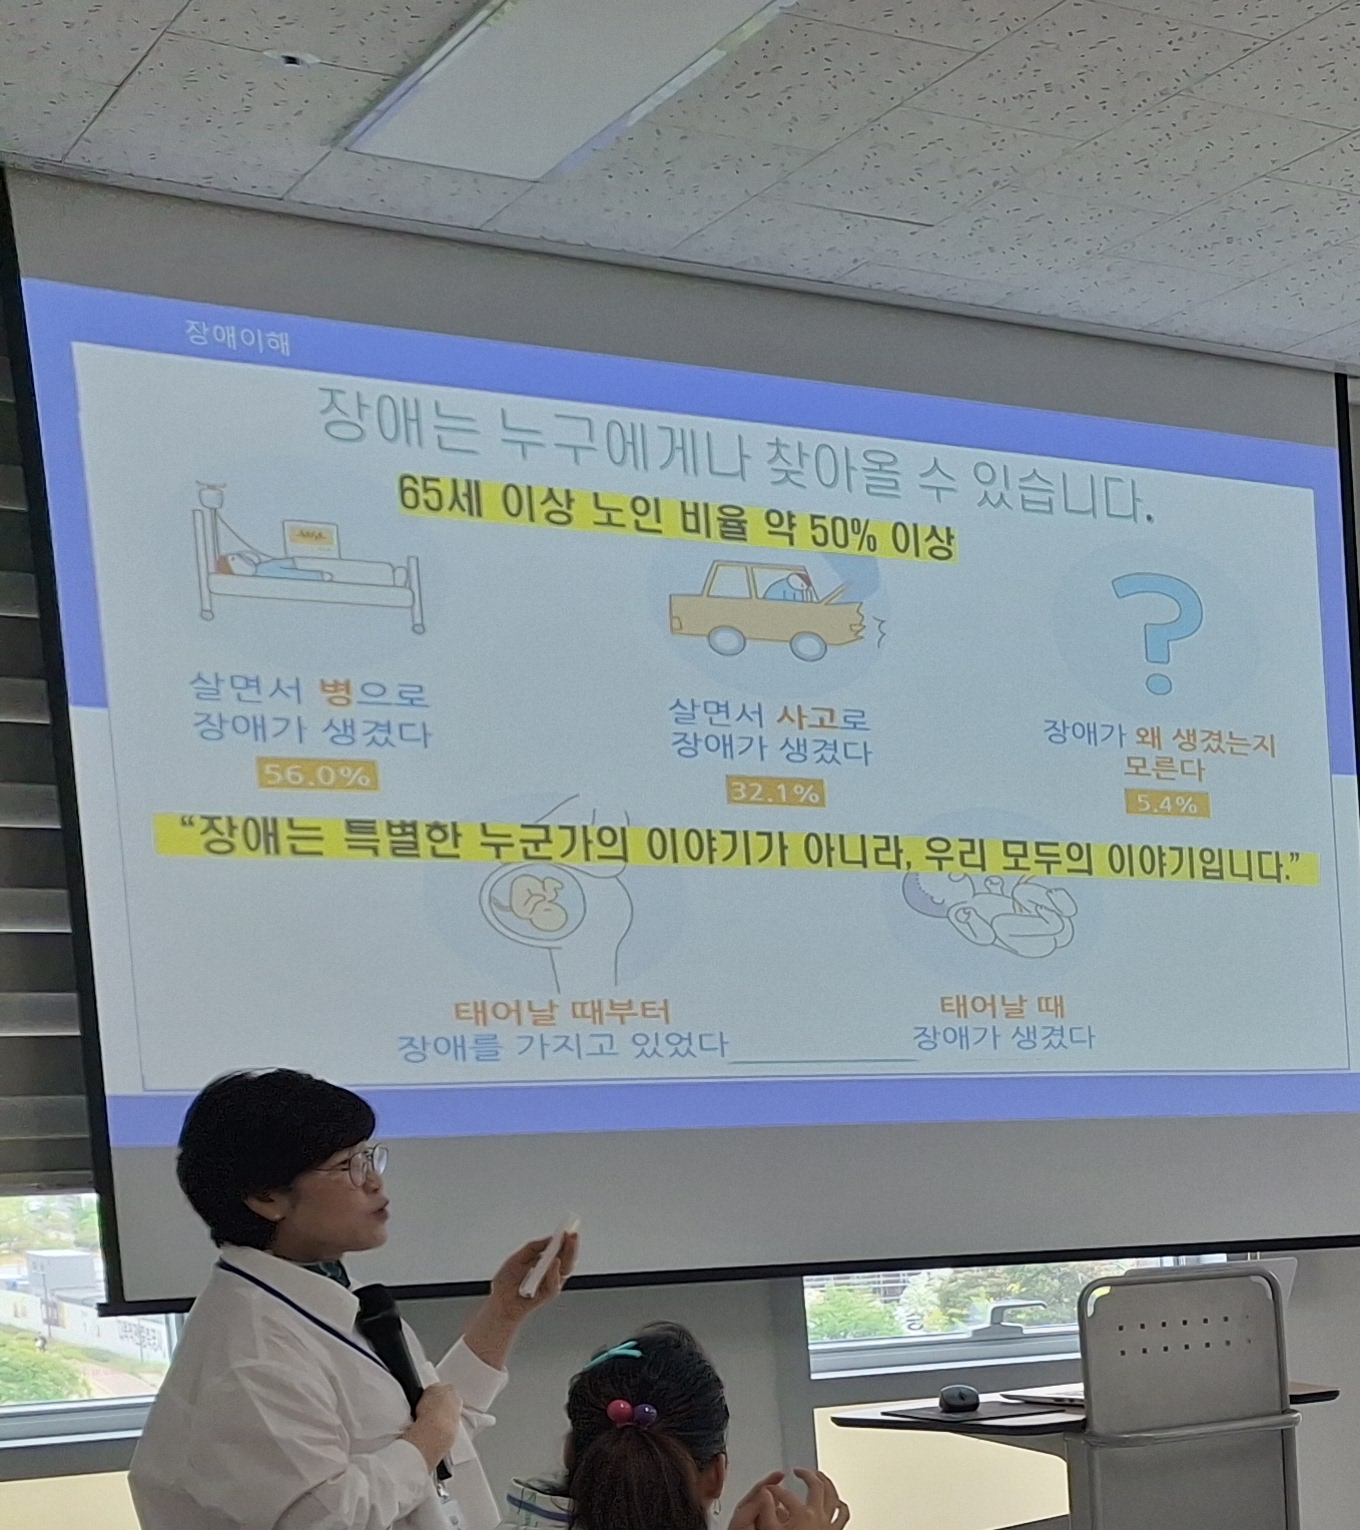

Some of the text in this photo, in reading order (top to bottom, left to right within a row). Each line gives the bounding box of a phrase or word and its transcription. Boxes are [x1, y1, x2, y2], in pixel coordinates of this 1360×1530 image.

[186, 319, 291, 356] 장애이해
[319, 386, 1156, 524] 장애는 누구에게나 찾아올 수 있습니다.
[398, 473, 956, 560] 65세 이상 노인 비율 약 50% 이상
[189, 672, 430, 709] 살면서 병으로
[192, 711, 432, 749] 장애가 생겼다
[670, 698, 870, 732] 살면서 사고로
[672, 732, 872, 767] 장애가 생겼다
[1044, 717, 1277, 758] 장애가 왜 생겼는지
[265, 763, 370, 788] 56.0%
[1124, 756, 1205, 783] 모른다
[731, 781, 820, 805] 32.1%
[1137, 794, 1198, 815] 5.4%
[344, 820, 460, 860] 특별한
[480, 823, 628, 863] 누군가의
[647, 826, 788, 868] 이야기가
[804, 832, 911, 871] 아니라,
[925, 836, 988, 873] 우리
[1002, 839, 1093, 875] 모두의
[454, 998, 670, 1027] 태어날 때부터
[940, 993, 1066, 1019] 태어날 때
[398, 1031, 729, 1063] 장애를 가지고 있었다
[913, 1023, 1095, 1052] 장애가 생겼다
